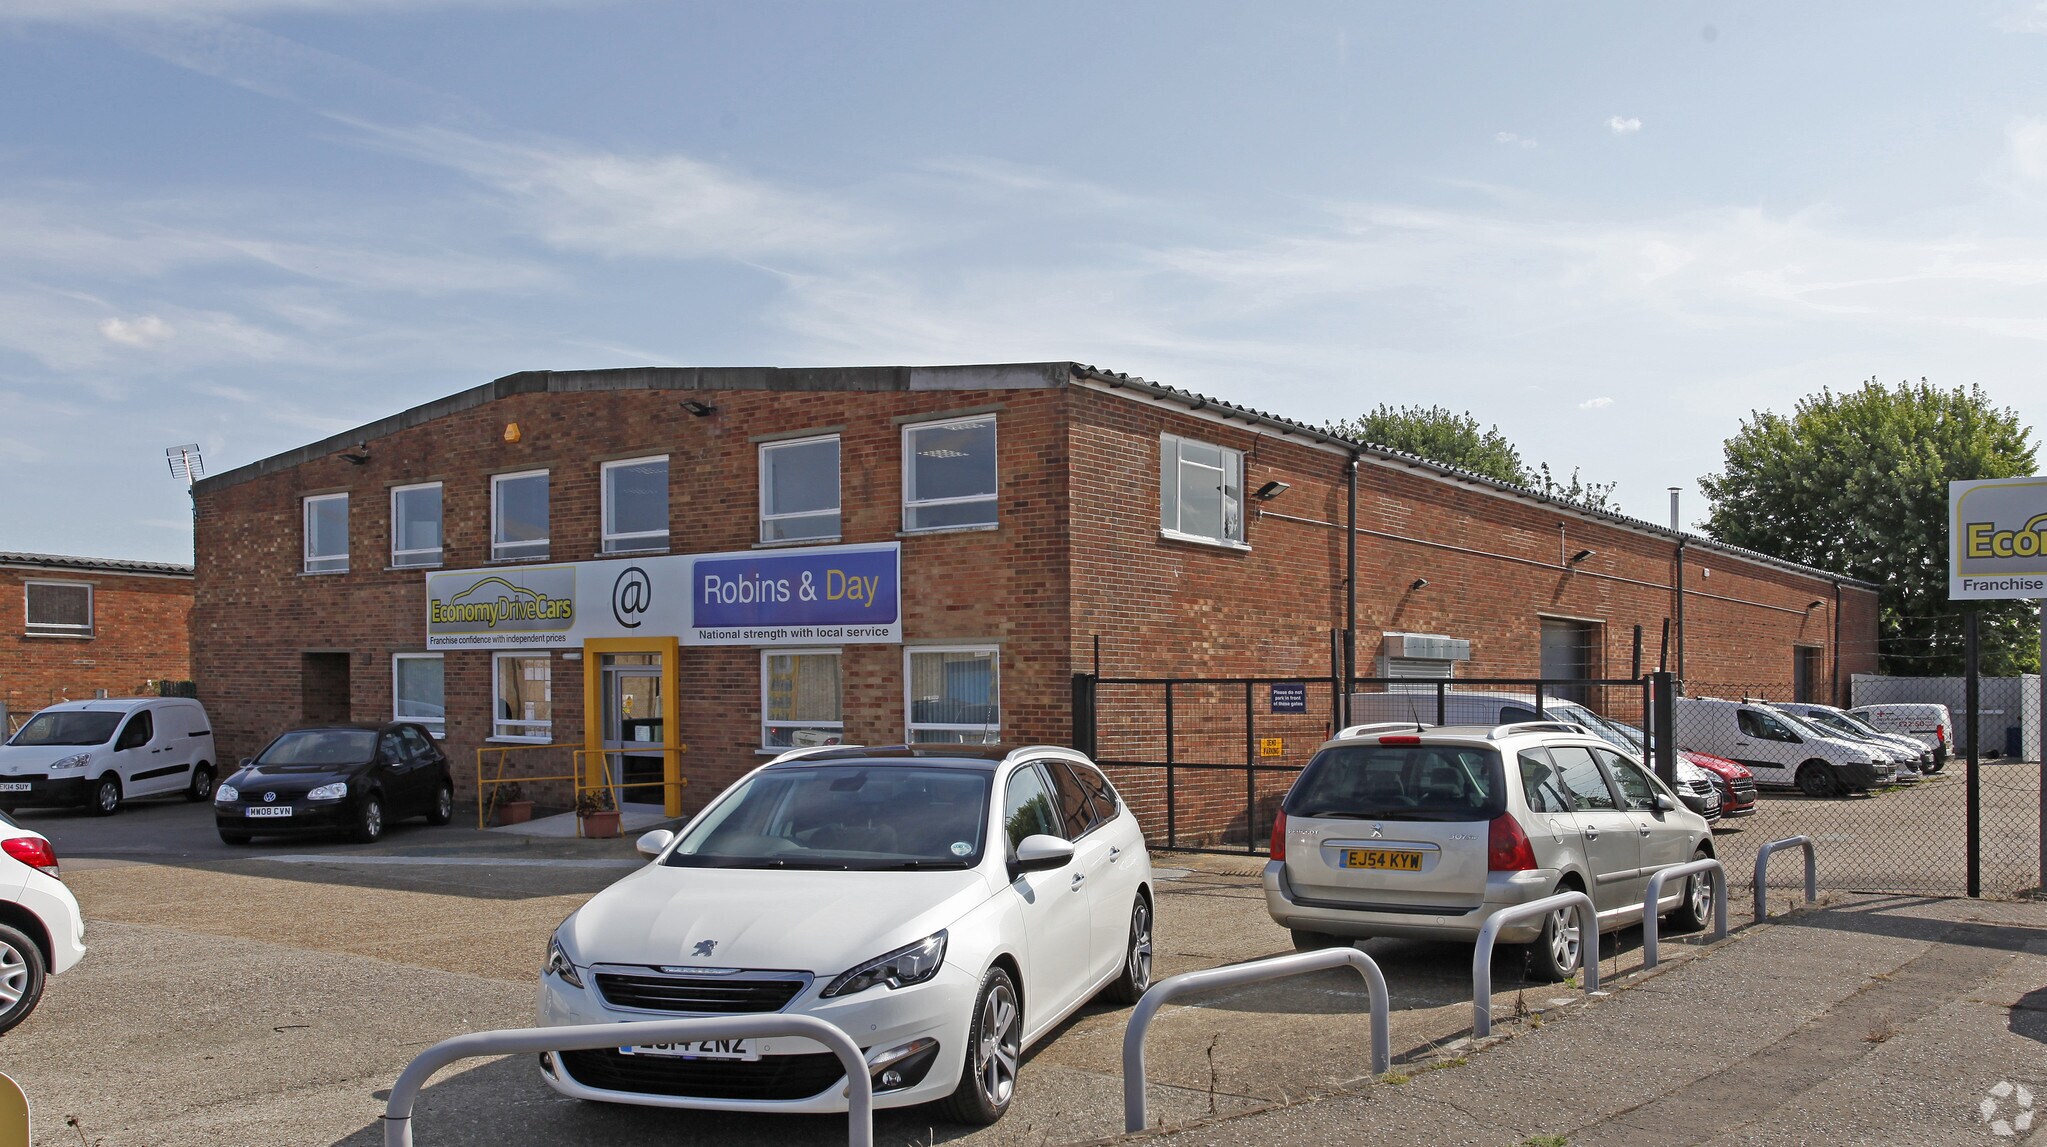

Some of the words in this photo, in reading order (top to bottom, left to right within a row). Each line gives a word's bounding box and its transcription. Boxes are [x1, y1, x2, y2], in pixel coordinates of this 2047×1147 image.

[704, 573, 791, 604] Robins
[798, 570, 818, 602] &
[826, 569, 879, 607] Day
[1963, 578, 2044, 591] Franchise
[612, 566, 652, 628] @
[431, 593, 573, 628] EconomyDriveCars
[430, 635, 458, 645] Franchise
[459, 634, 492, 644] confidence
[492, 634, 506, 643] with
[506, 633, 546, 645] independent
[546, 633, 567, 643] prices
[699, 629, 741, 640] National
[743, 628, 788, 641] strength
[790, 627, 813, 638] with
[816, 627, 843, 638] local
[846, 626, 889, 637] service
[250, 807, 272, 816] MW08
[273, 807, 291, 815] CVN
[1348, 852, 1386, 867] EJ54
[1389, 853, 1421, 869] KYW
